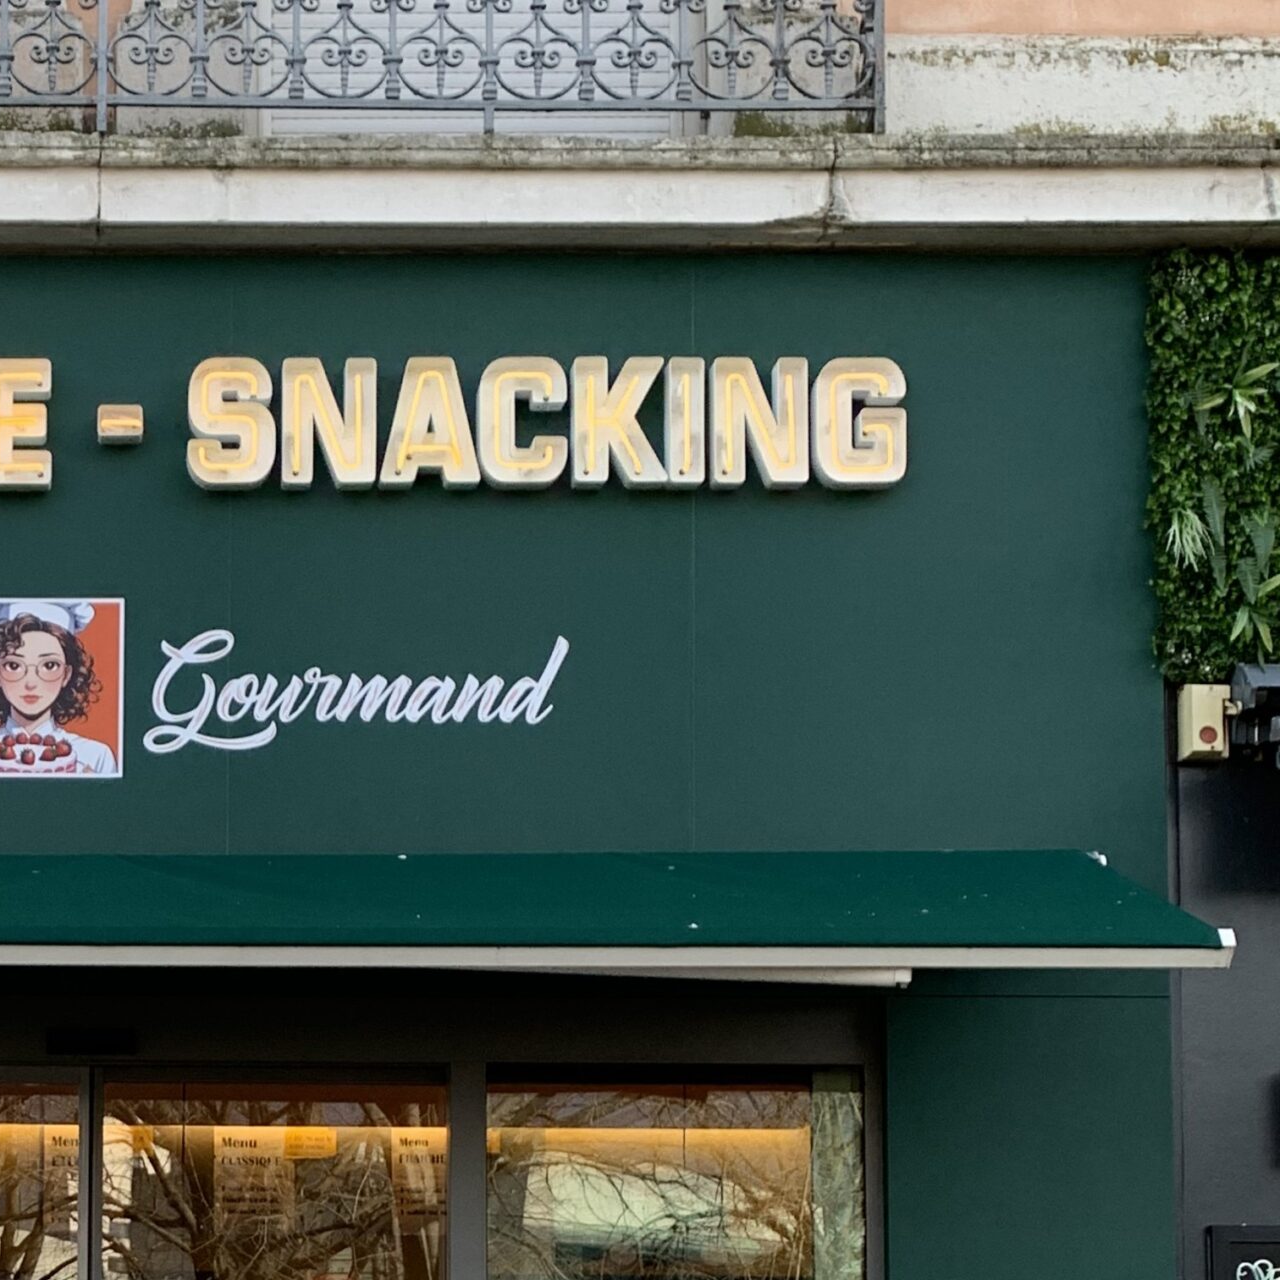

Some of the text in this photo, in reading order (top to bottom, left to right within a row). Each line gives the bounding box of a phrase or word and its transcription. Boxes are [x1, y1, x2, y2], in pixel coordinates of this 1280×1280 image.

[187, 355, 908, 491] SNACKING
[143, 629, 570, 753] Gourmand
[52, 1136, 79, 1147] Men
[222, 1137, 257, 1148] Menu
[400, 1138, 429, 1147] Menu
